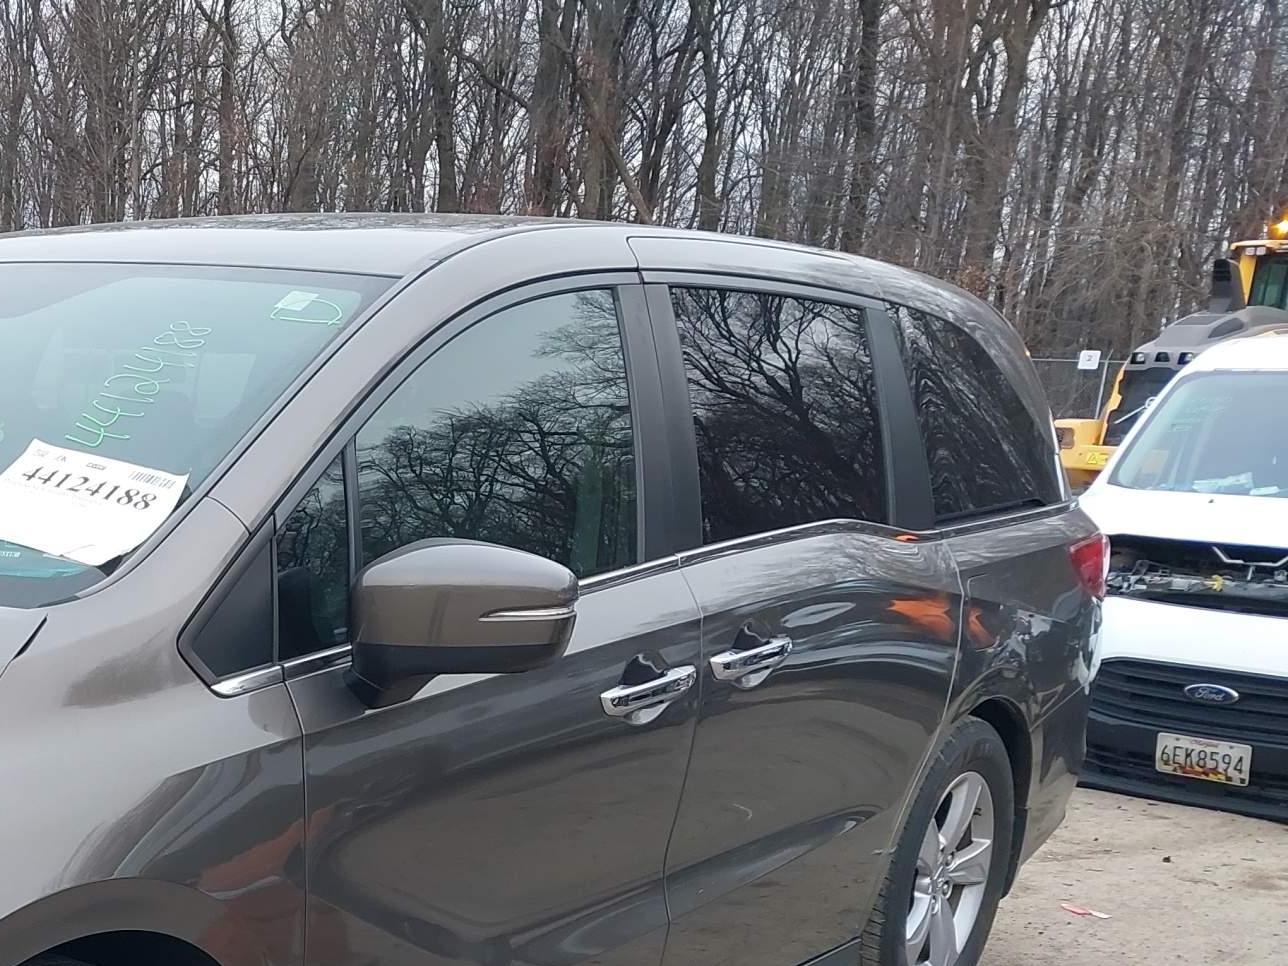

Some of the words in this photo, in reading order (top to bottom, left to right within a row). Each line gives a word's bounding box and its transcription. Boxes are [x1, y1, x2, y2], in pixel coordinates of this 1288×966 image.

[64, 320, 212, 447] 44124188
[22, 466, 157, 510] 44124188
[1160, 744, 1244, 775] 6EK8594
